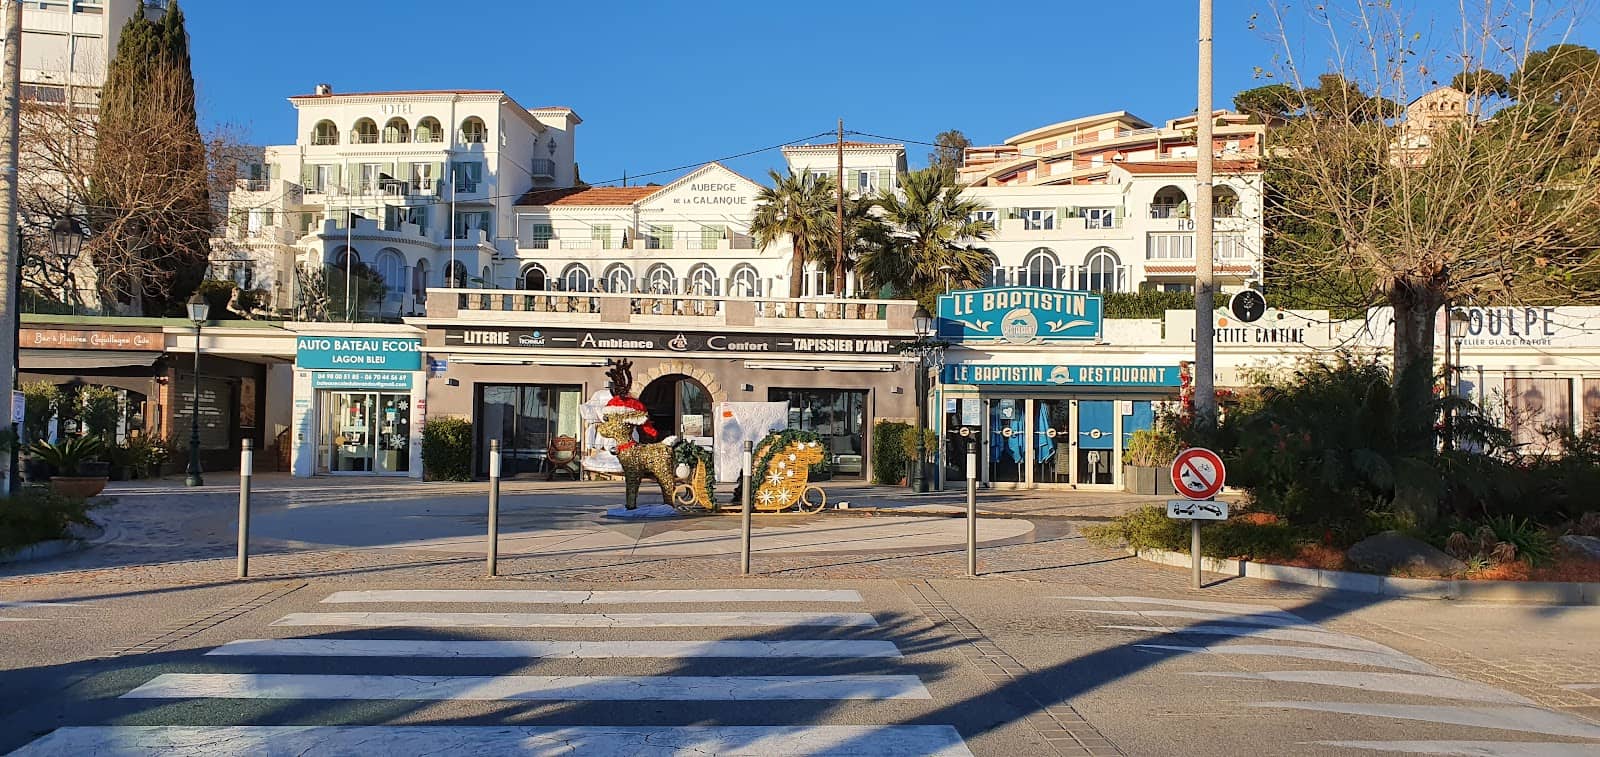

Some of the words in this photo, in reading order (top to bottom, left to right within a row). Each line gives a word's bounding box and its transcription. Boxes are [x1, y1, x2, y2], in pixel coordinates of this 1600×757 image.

[690, 183, 737, 192] AUBERGE
[693, 196, 748, 205] CALANQUE
[954, 295, 974, 316] LE
[983, 291, 1086, 317] BAPTISTIN
[1466, 308, 1555, 336] OULPE
[34, 332, 50, 344] Bar
[463, 331, 510, 345] LITERIE
[581, 332, 654, 349] Ambiance
[1256, 328, 1305, 343] CANTINE
[298, 339, 331, 350] AUTO
[334, 340, 379, 352] BATEAU
[382, 341, 421, 352] ECOLE
[706, 336, 768, 351] Confort
[792, 338, 854, 352] TAPISSIER
[855, 339, 890, 353] D'ART
[332, 355, 364, 364] LAGON
[366, 355, 386, 364] BLEU
[953, 367, 969, 381] LE
[974, 367, 1043, 382] BAPTISTIN
[1079, 367, 1166, 383] RESTAURANT
